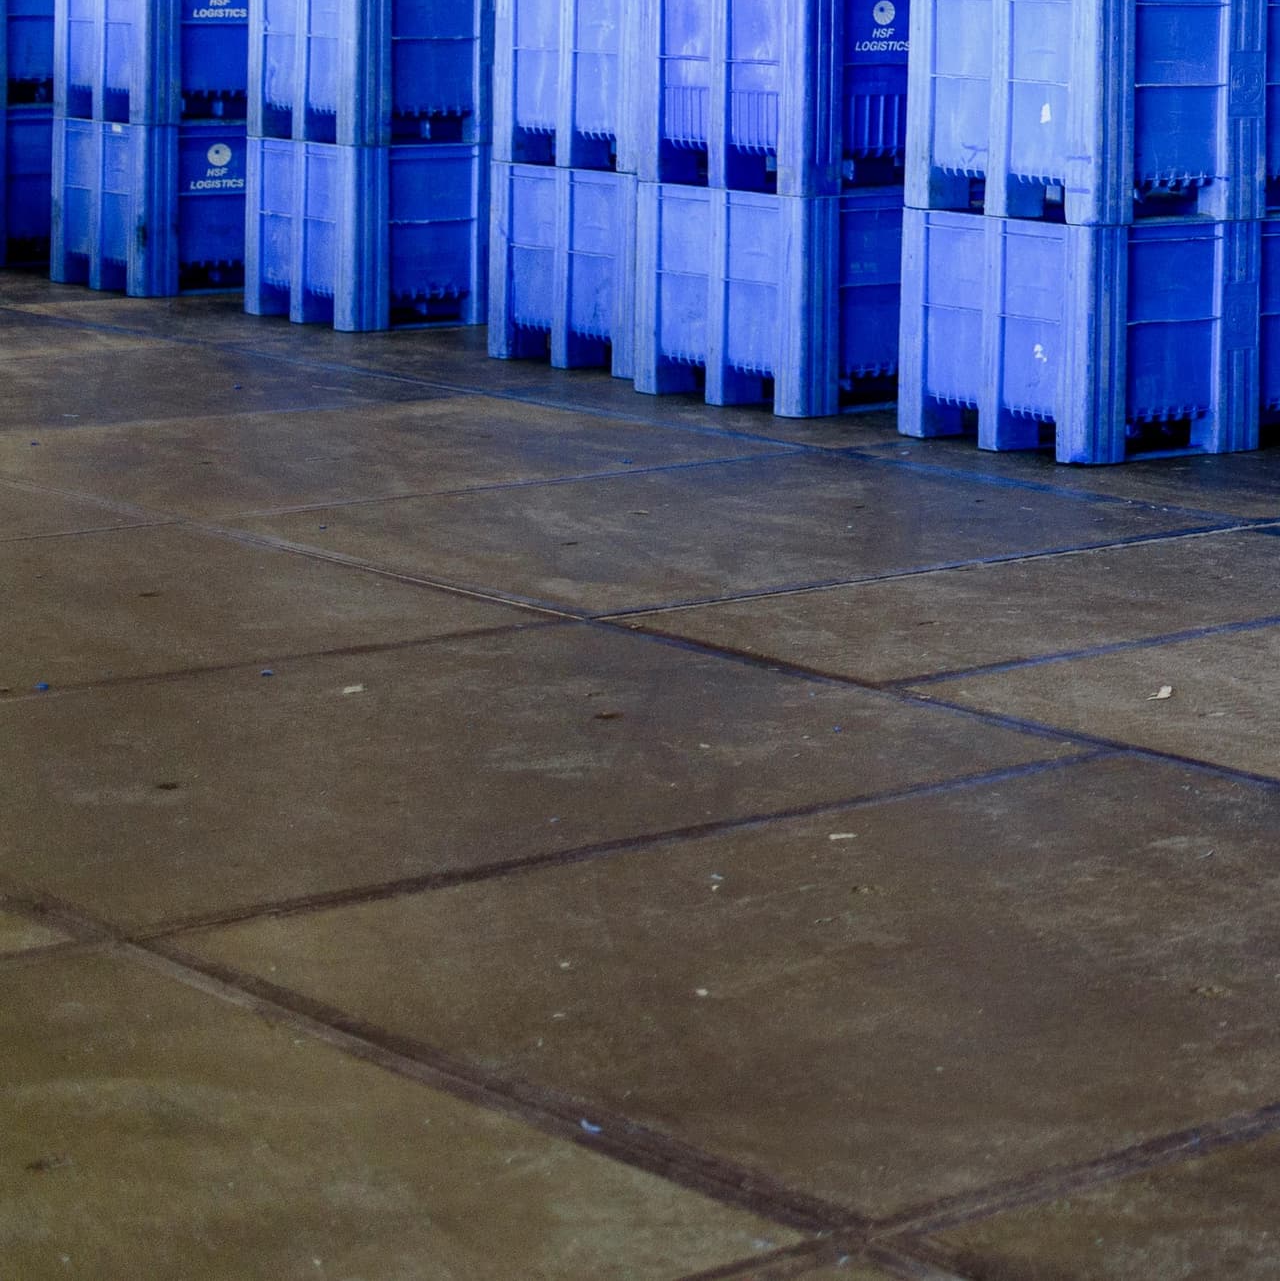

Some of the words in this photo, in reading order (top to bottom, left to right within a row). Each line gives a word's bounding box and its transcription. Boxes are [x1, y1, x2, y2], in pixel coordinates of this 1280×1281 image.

[192, 8, 247, 18] LOGISTICS
[872, 27, 895, 39] HSF
[855, 40, 912, 52] LOGISTICS
[206, 167, 229, 178] HSF
[190, 178, 245, 190] LOGISTICS
